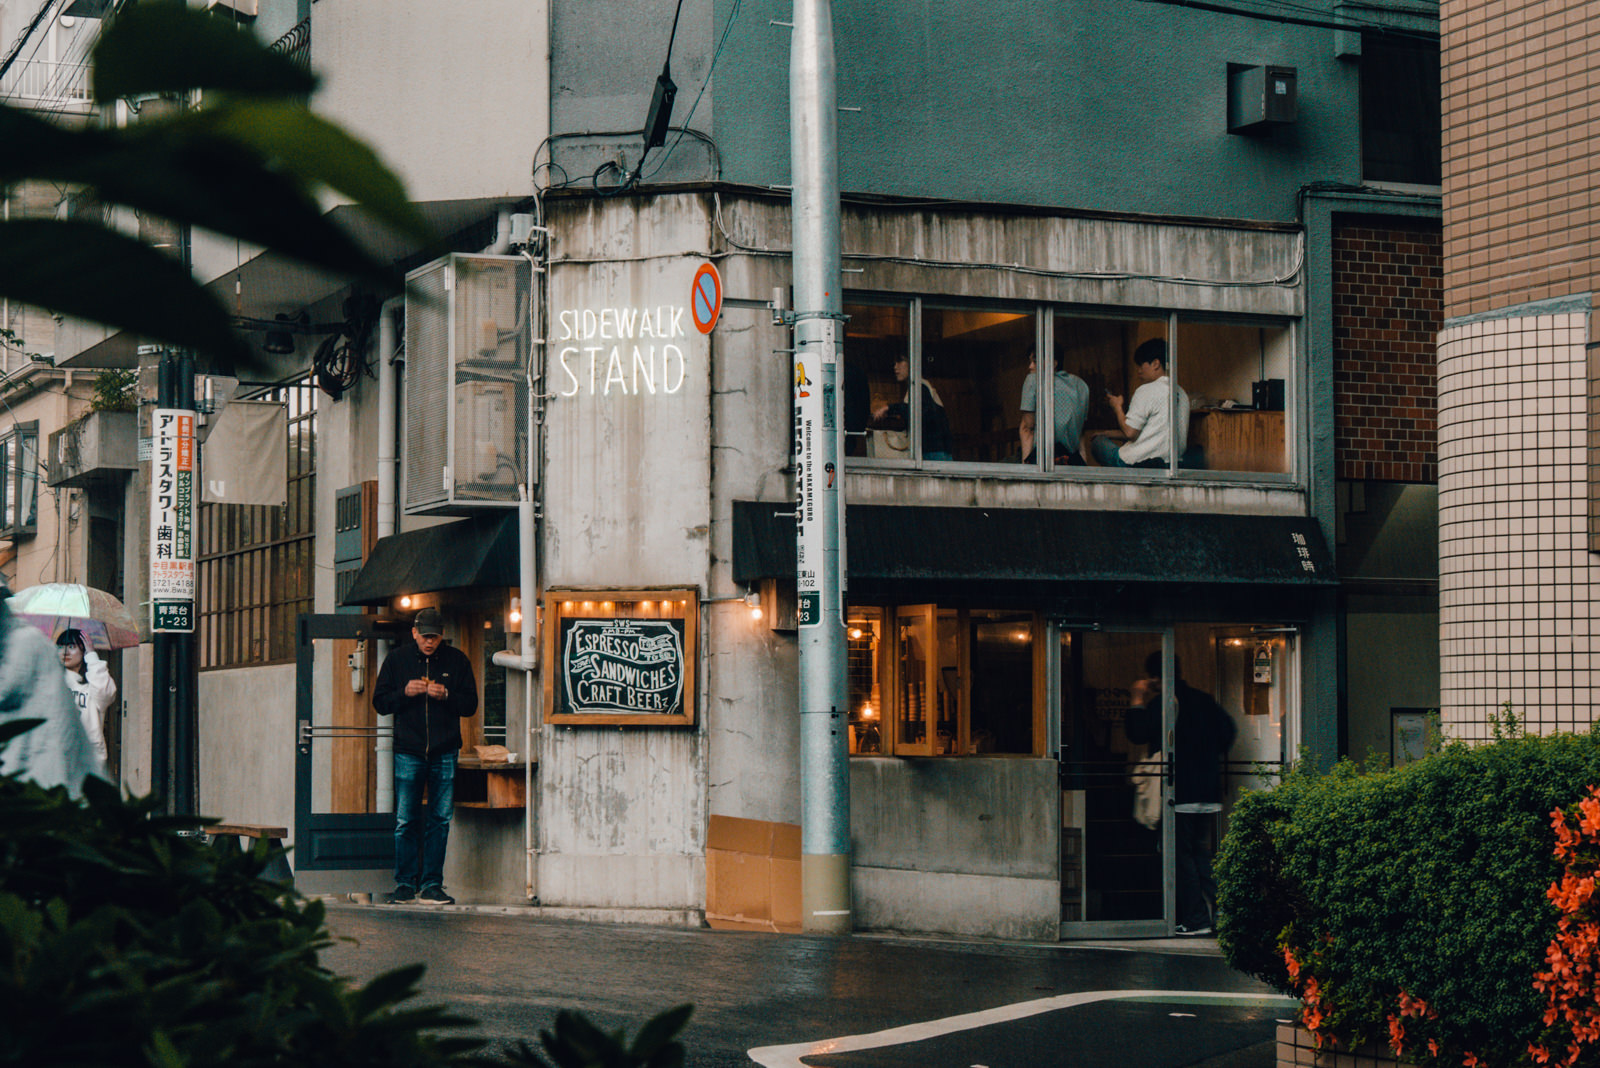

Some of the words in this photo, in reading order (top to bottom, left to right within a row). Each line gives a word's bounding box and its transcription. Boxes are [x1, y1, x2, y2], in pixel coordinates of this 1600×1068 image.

[559, 304, 685, 341] SIDEWALK
[559, 343, 685, 397] STAND
[805, 419, 813, 452] Welcome
[805, 452, 813, 460] to
[805, 460, 813, 472] the
[157, 414, 174, 560] アトラスタワー歯科
[805, 473, 814, 522] NAKAMEGURO
[158, 605, 188, 615] 青葉台
[159, 616, 188, 626] 1-23
[575, 628, 639, 661] ESPRESSO
[590, 653, 676, 690] SANDWICHES
[577, 680, 622, 705] CRAFT
